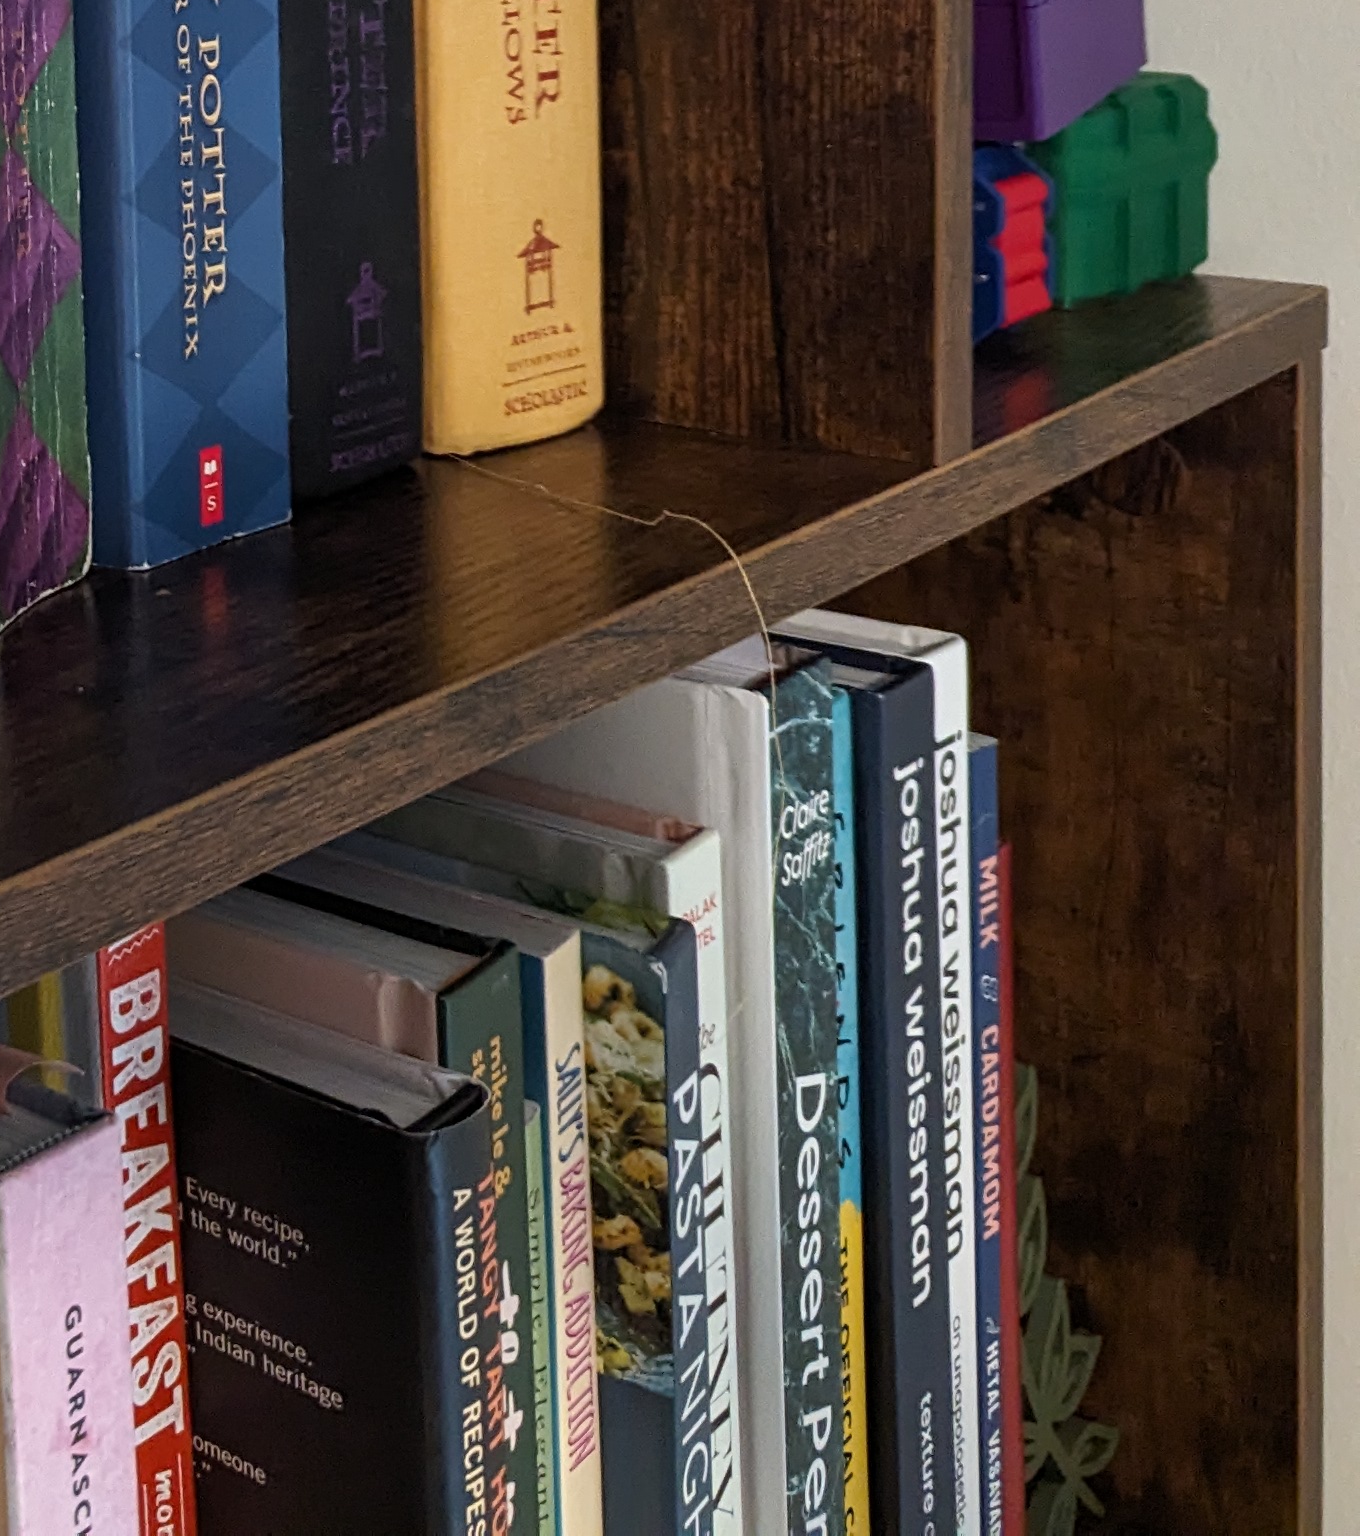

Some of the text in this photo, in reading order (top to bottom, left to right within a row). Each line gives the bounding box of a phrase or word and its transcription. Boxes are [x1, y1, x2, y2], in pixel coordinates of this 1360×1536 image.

[176, 24, 192, 75] OF
[179, 84, 195, 167] THE
[198, 34, 228, 308] POTTER
[181, 179, 199, 360] PHOENIX
[780, 789, 830, 840] Claire
[781, 830, 831, 887] Saffitz
[893, 757, 935, 1310] joshua weissman
[935, 729, 966, 1261] joshua weissman
[979, 855, 1001, 1241] MILK CARDAMOM
[489, 1035, 508, 1121] mike
[108, 968, 186, 1448] BREAKFAST
[185, 1176, 311, 1253] Every recipe,
[191, 1208, 222, 1239] the
[555, 1042, 596, 1472] SALLY'S BAKING ADDICTION
[673, 1070, 705, 1349] PASTA
[795, 1073, 829, 1389] Dessert
[194, 1320, 345, 1411] Indian heritage
[202, 1298, 313, 1366] experience.
[453, 1188, 487, 1536] A WORLD OF RECIPES
[476, 1162, 507, 1450] TANGY TART
[985, 1340, 1001, 1421] HETAL
[919, 1390, 936, 1514] texture
